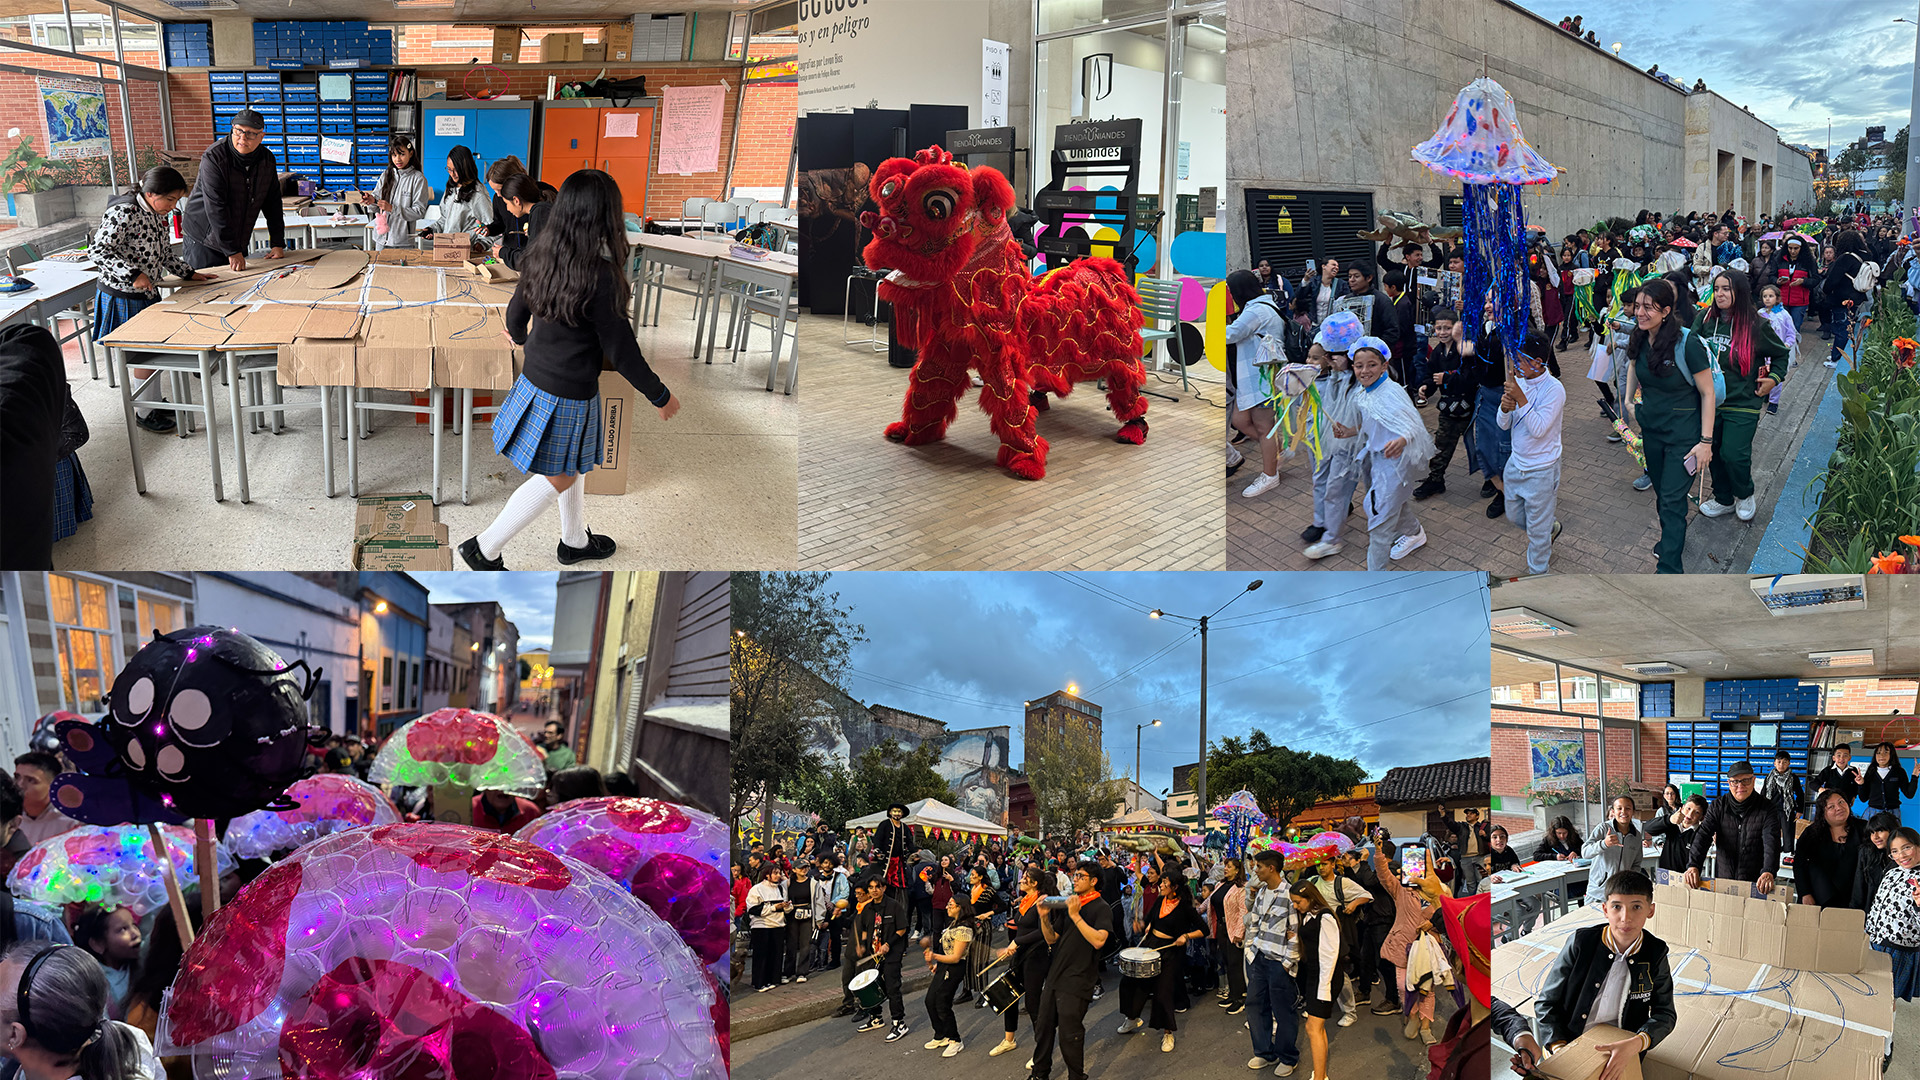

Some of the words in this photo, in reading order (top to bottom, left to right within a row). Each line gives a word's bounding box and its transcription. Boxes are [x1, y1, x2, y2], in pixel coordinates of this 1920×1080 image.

[809, 30, 815, 47] y
[817, 26, 829, 39] en
[830, 16, 870, 43] peligro
[1064, 132, 1088, 142] TIENDA
[1087, 127, 1126, 142] UNIANDES
[953, 139, 972, 148] TIENDA
[1070, 146, 1120, 159] Uniandes
[609, 404, 618, 429] ARRIBA
[608, 429, 616, 447] LADO
[606, 448, 614, 464] ESTE
